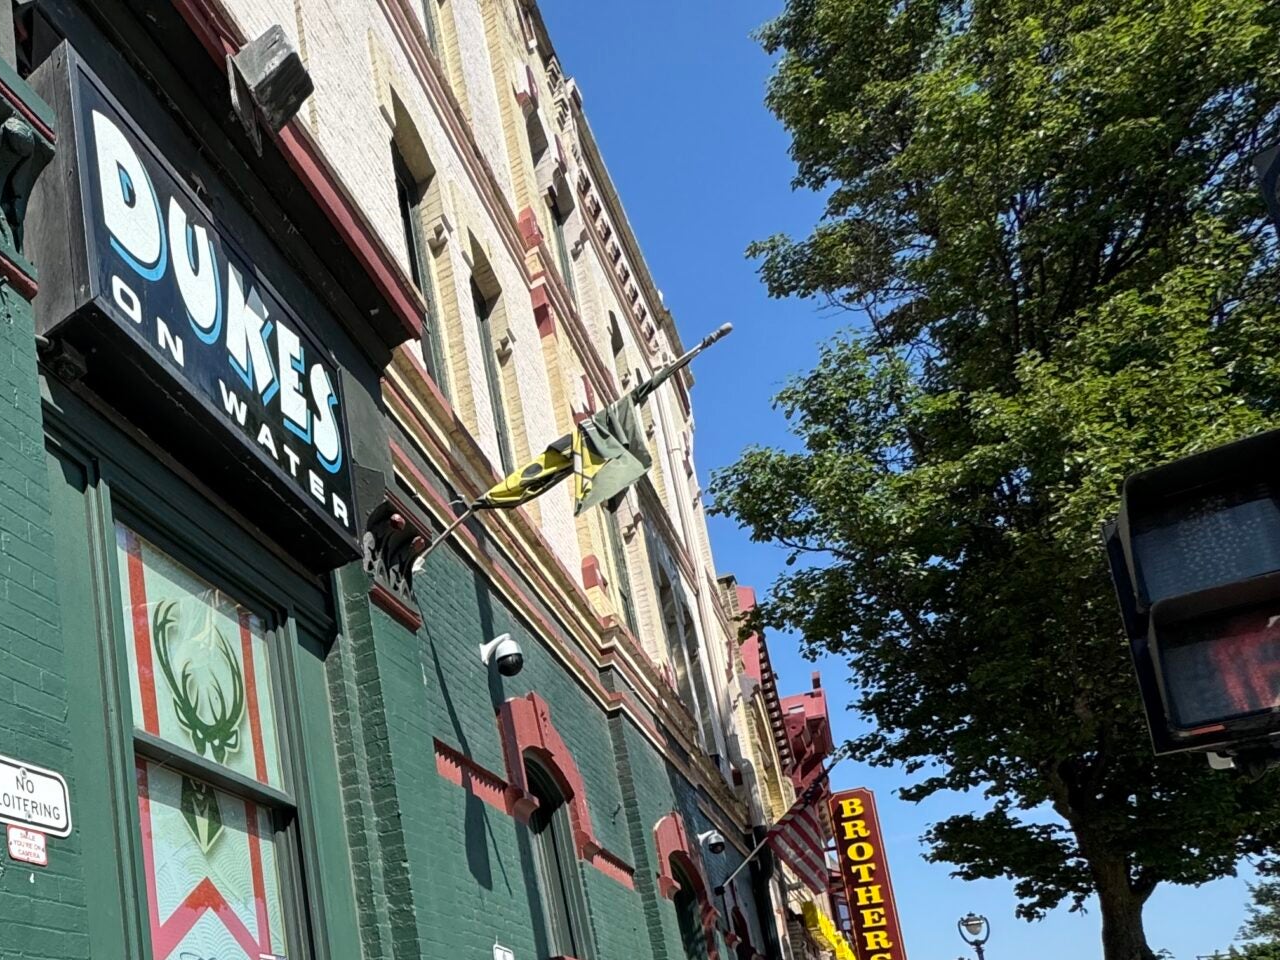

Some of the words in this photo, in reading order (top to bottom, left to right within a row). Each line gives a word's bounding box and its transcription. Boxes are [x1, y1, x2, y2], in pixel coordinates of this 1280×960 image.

[92, 109, 342, 474] DUKES
[111, 275, 185, 367] ON
[219, 378, 349, 528] WATER
[15, 775, 35, 794] NO
